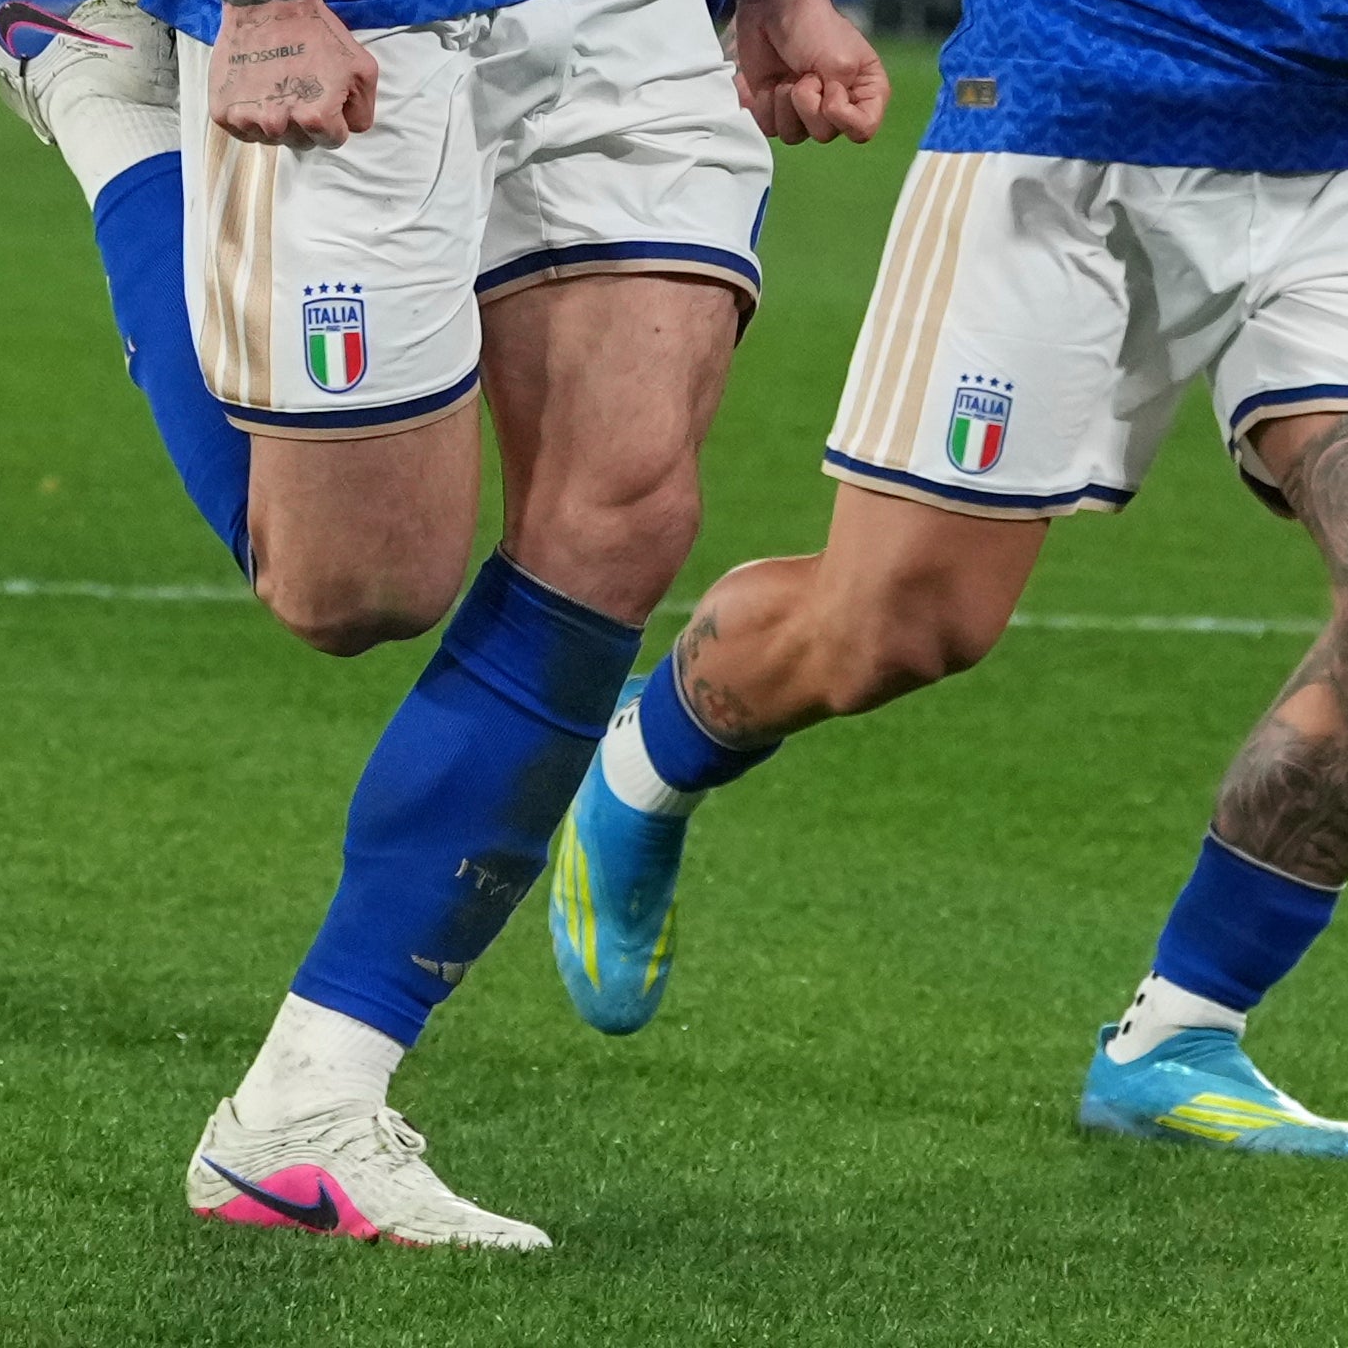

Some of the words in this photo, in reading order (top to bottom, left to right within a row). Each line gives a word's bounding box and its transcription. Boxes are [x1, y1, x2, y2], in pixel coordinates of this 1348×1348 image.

[228, 43, 305, 65] IMPOSSIBLE
[308, 306, 358, 324] ITALIA
[958, 394, 1004, 416] ITALIA
